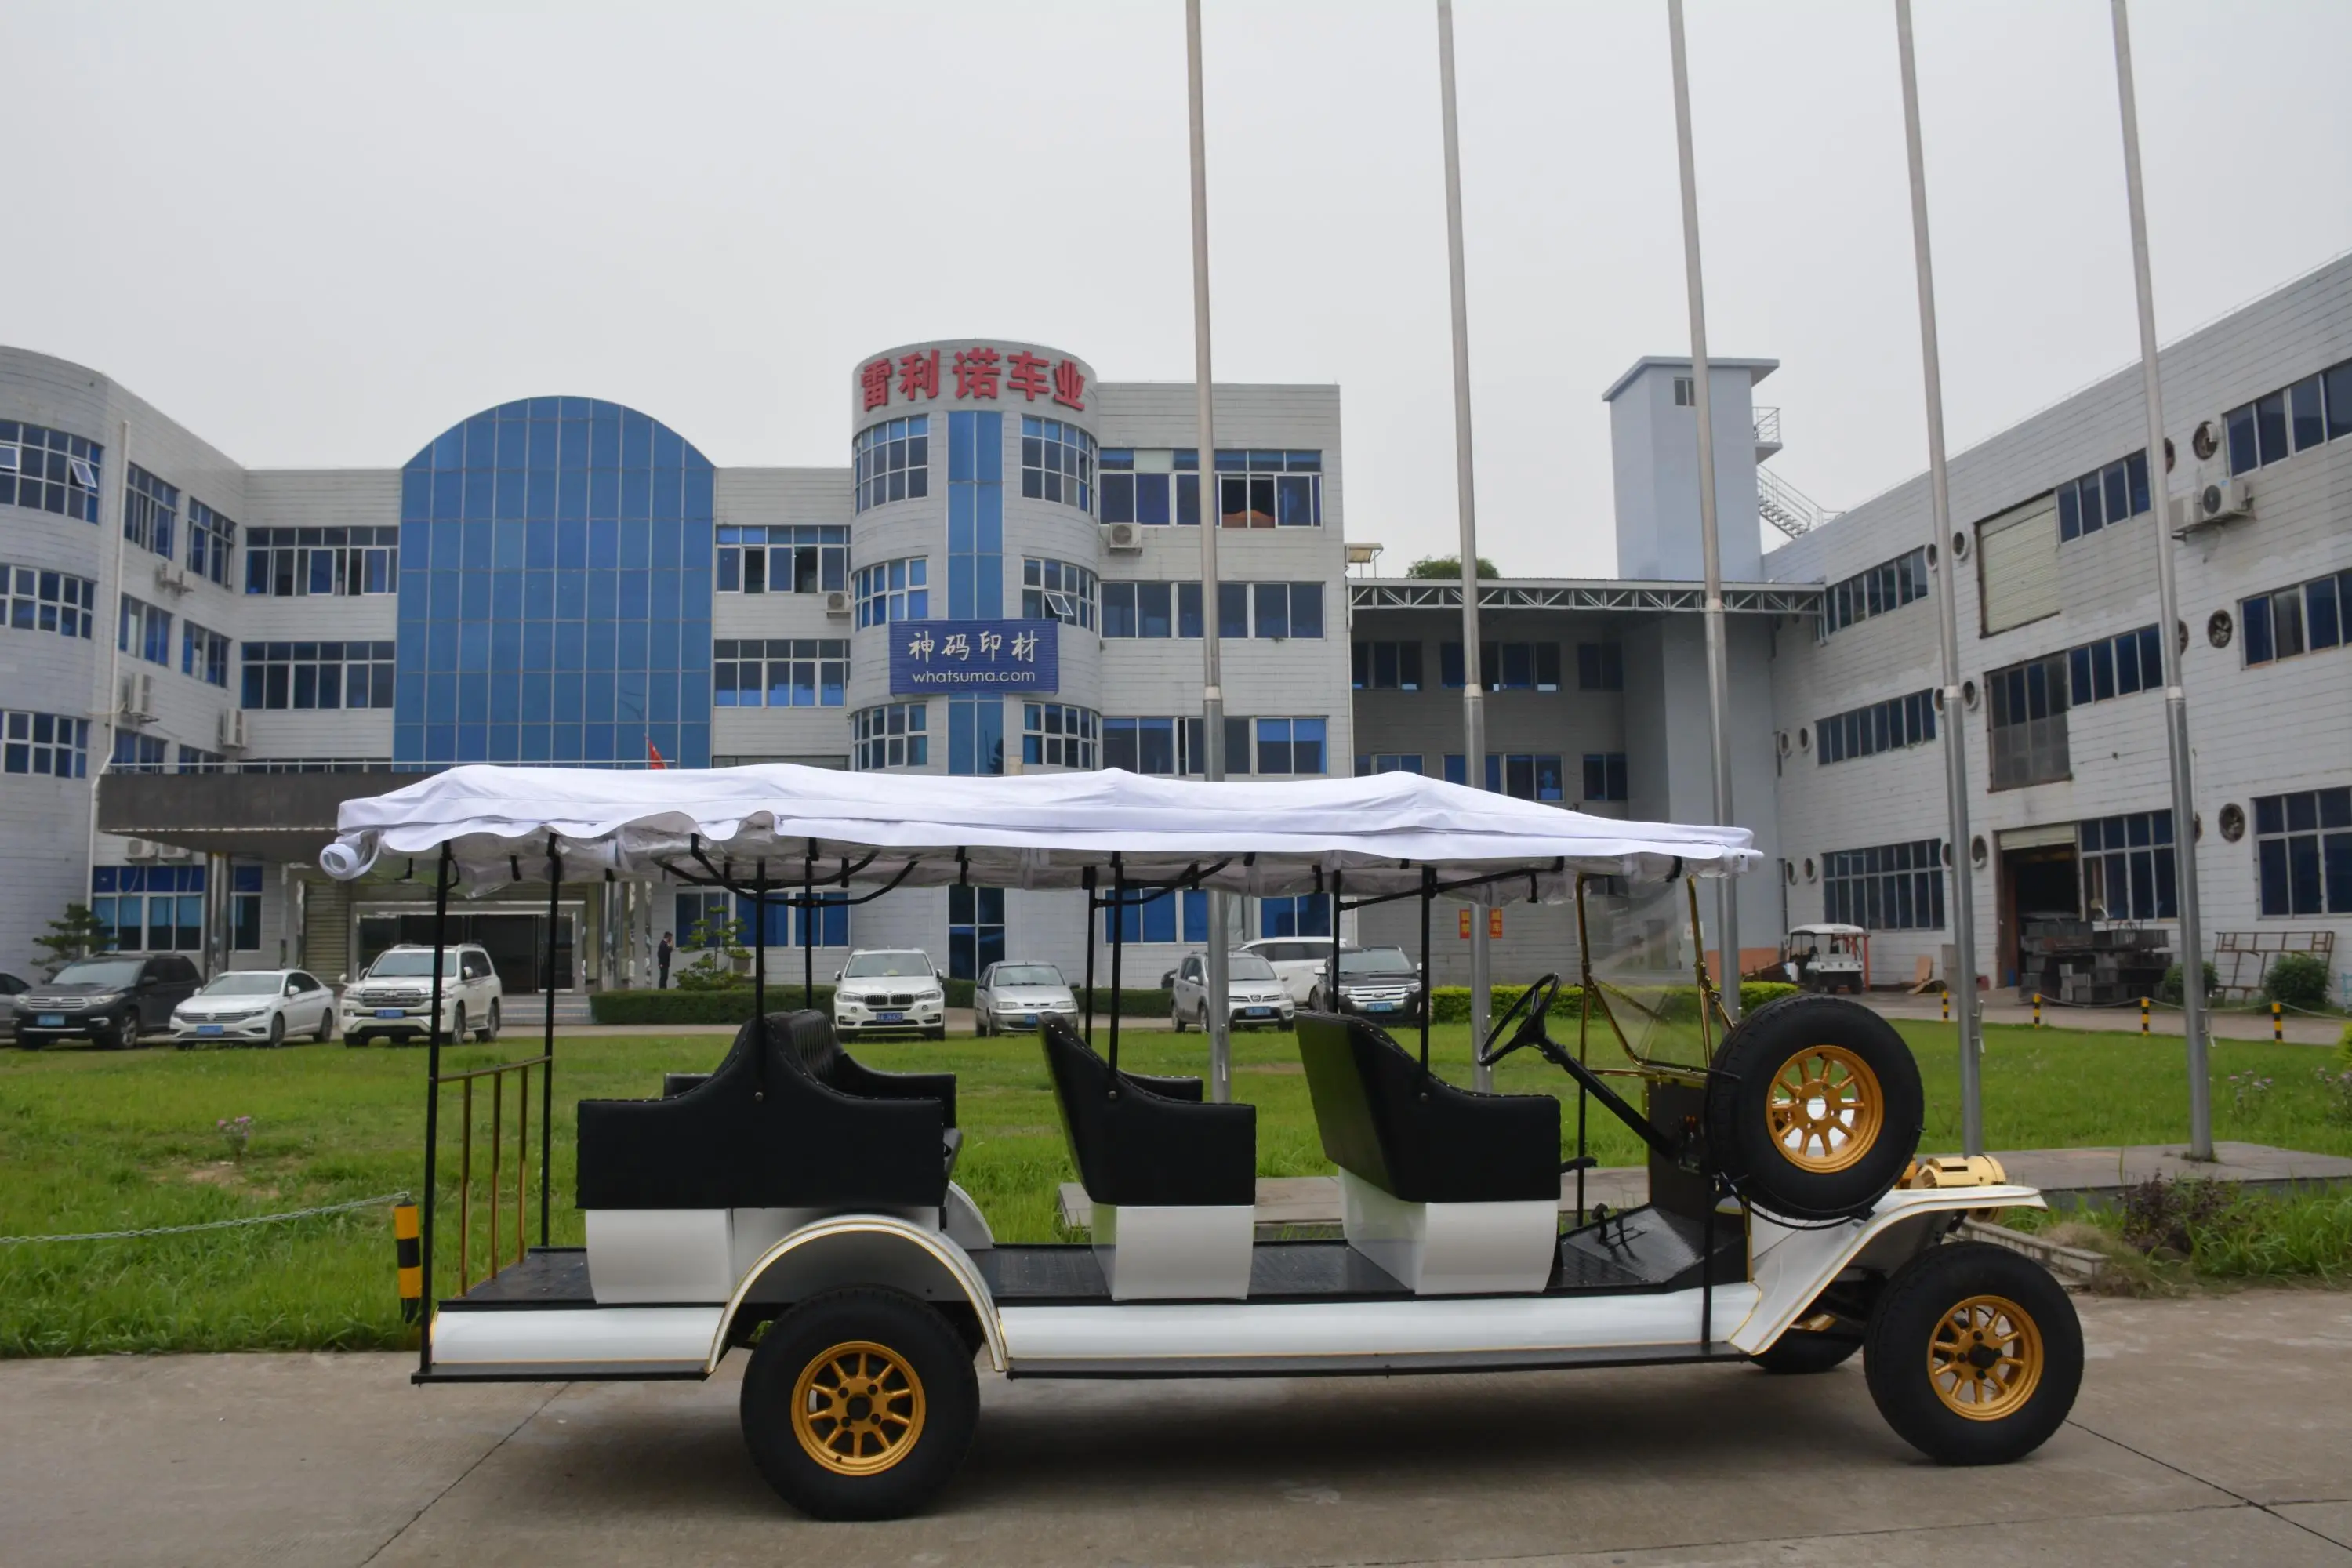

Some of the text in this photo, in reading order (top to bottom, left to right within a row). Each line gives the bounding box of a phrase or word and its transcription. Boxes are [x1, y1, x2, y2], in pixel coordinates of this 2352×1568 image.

[861, 347, 1085, 410] 雷利诺车业
[909, 630, 1039, 663] 神码印材
[912, 670, 1035, 683] whatsuma.com
